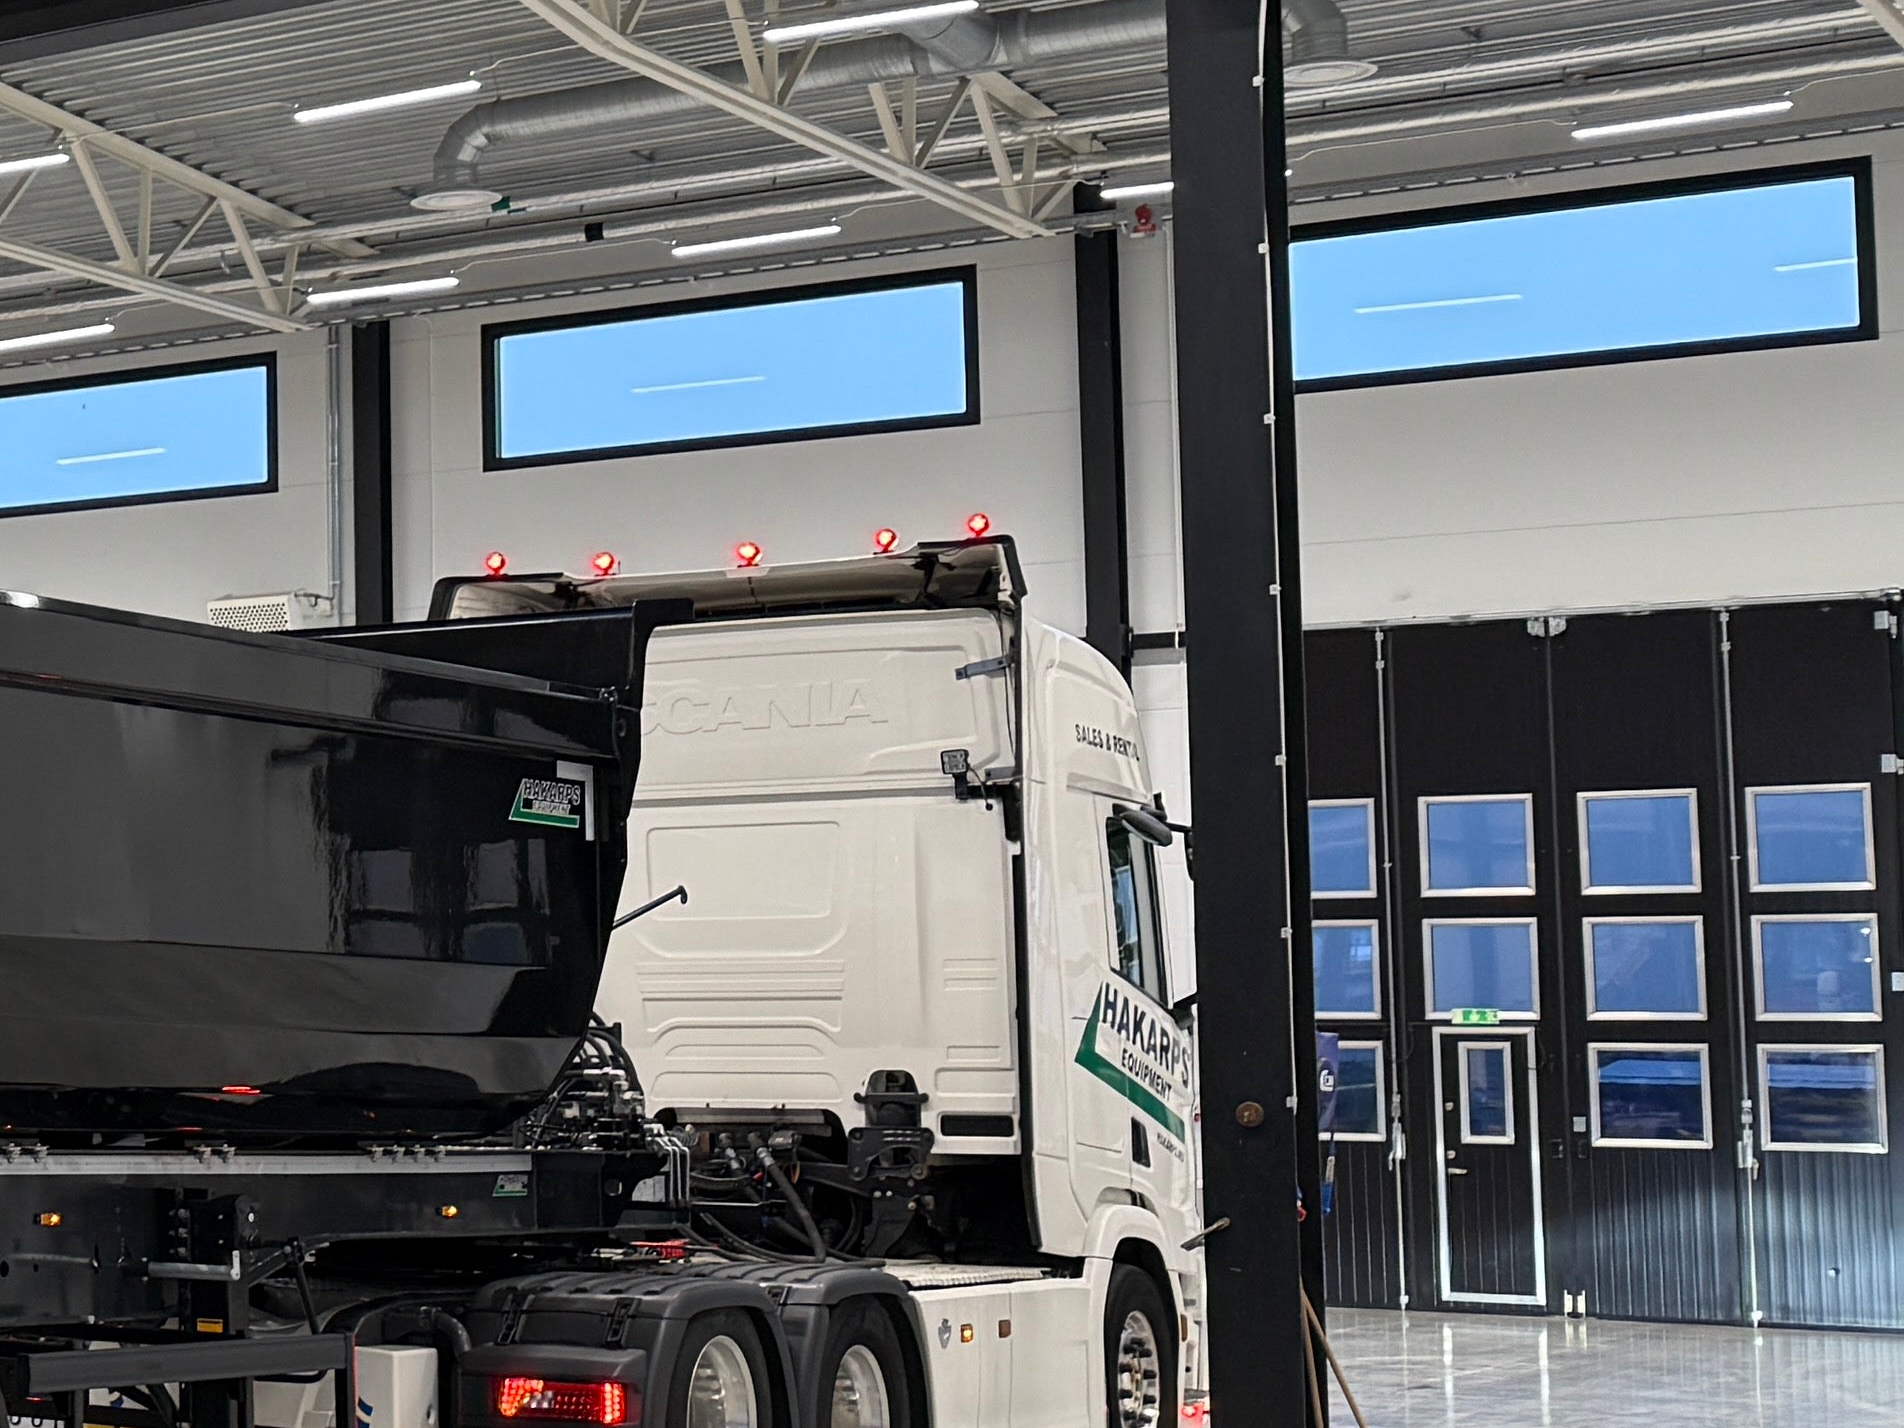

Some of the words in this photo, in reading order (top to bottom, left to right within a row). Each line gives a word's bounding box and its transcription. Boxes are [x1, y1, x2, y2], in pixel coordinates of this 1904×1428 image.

[1075, 723, 1104, 749] SALES
[1102, 981, 1192, 1090] HAKARPS
[1121, 1047, 1173, 1102] EQUIPMENT
